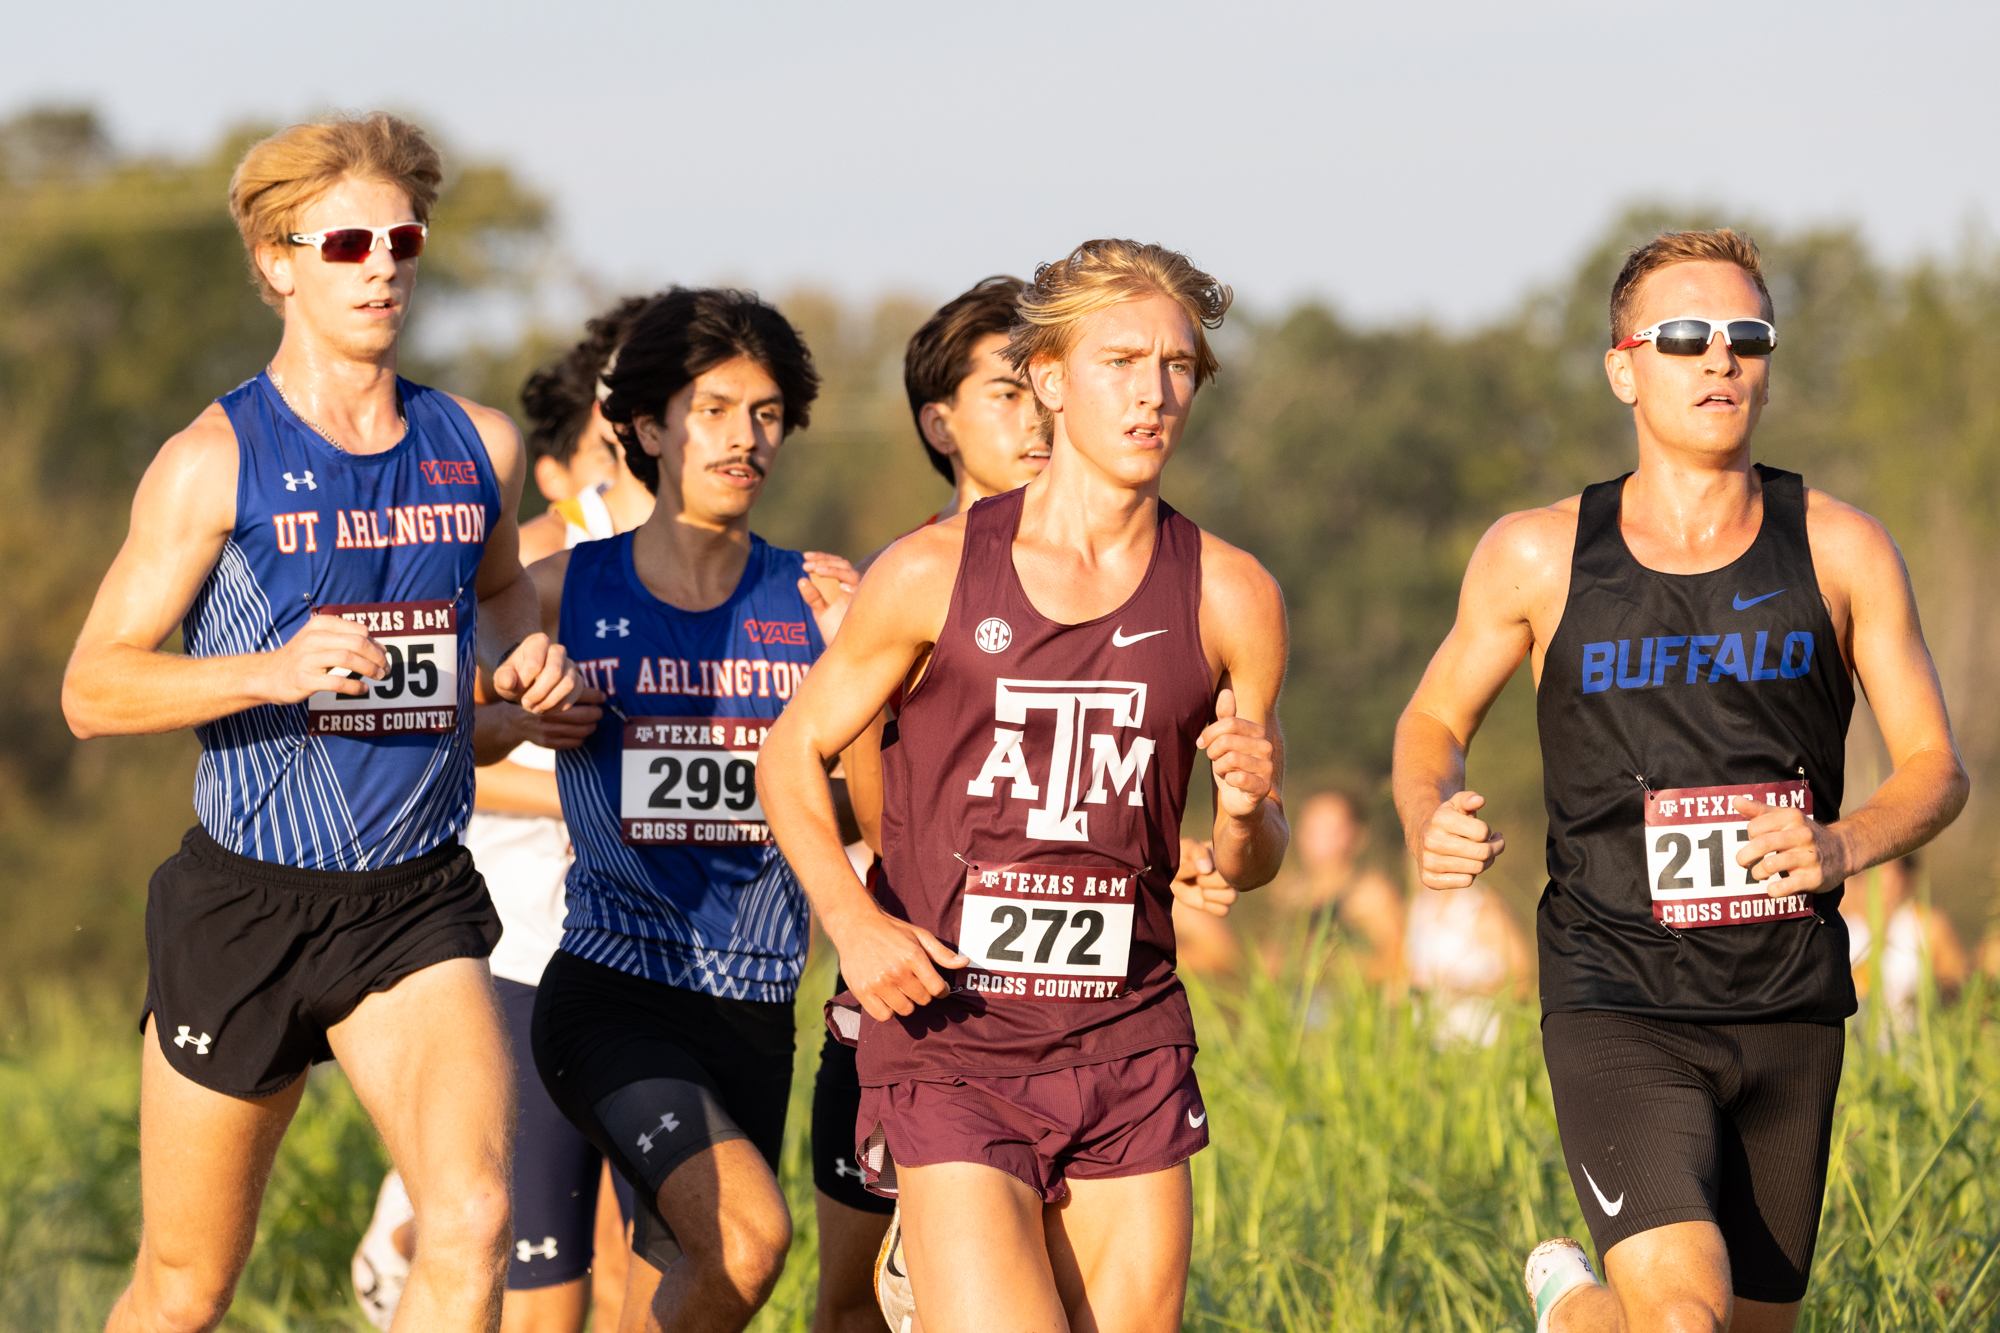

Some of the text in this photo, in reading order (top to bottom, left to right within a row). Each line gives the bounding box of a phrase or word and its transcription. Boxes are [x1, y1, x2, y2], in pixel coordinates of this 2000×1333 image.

[420, 459, 477, 486] WAC
[272, 503, 486, 554] UT ARLINGTON
[412, 608, 450, 630] A&M
[743, 618, 806, 645] WAC
[978, 619, 1010, 651] SEC
[336, 643, 438, 701] 95
[1581, 630, 1815, 694] BUFFALO
[577, 656, 811, 701] UT ARLINGTON
[318, 710, 455, 732] CROSS COUNTRY
[655, 724, 726, 746] TEXAS
[647, 756, 757, 812] 299
[1765, 788, 1805, 809] A&M
[631, 822, 770, 842] CROSS COUNTRY
[1002, 871, 1075, 896] TEXAS
[1083, 876, 1128, 897] A&M
[1662, 893, 1808, 924] CROSS COUNTRY
[985, 904, 1105, 966] 272
[966, 973, 1118, 998] CROSS COUNTRY
